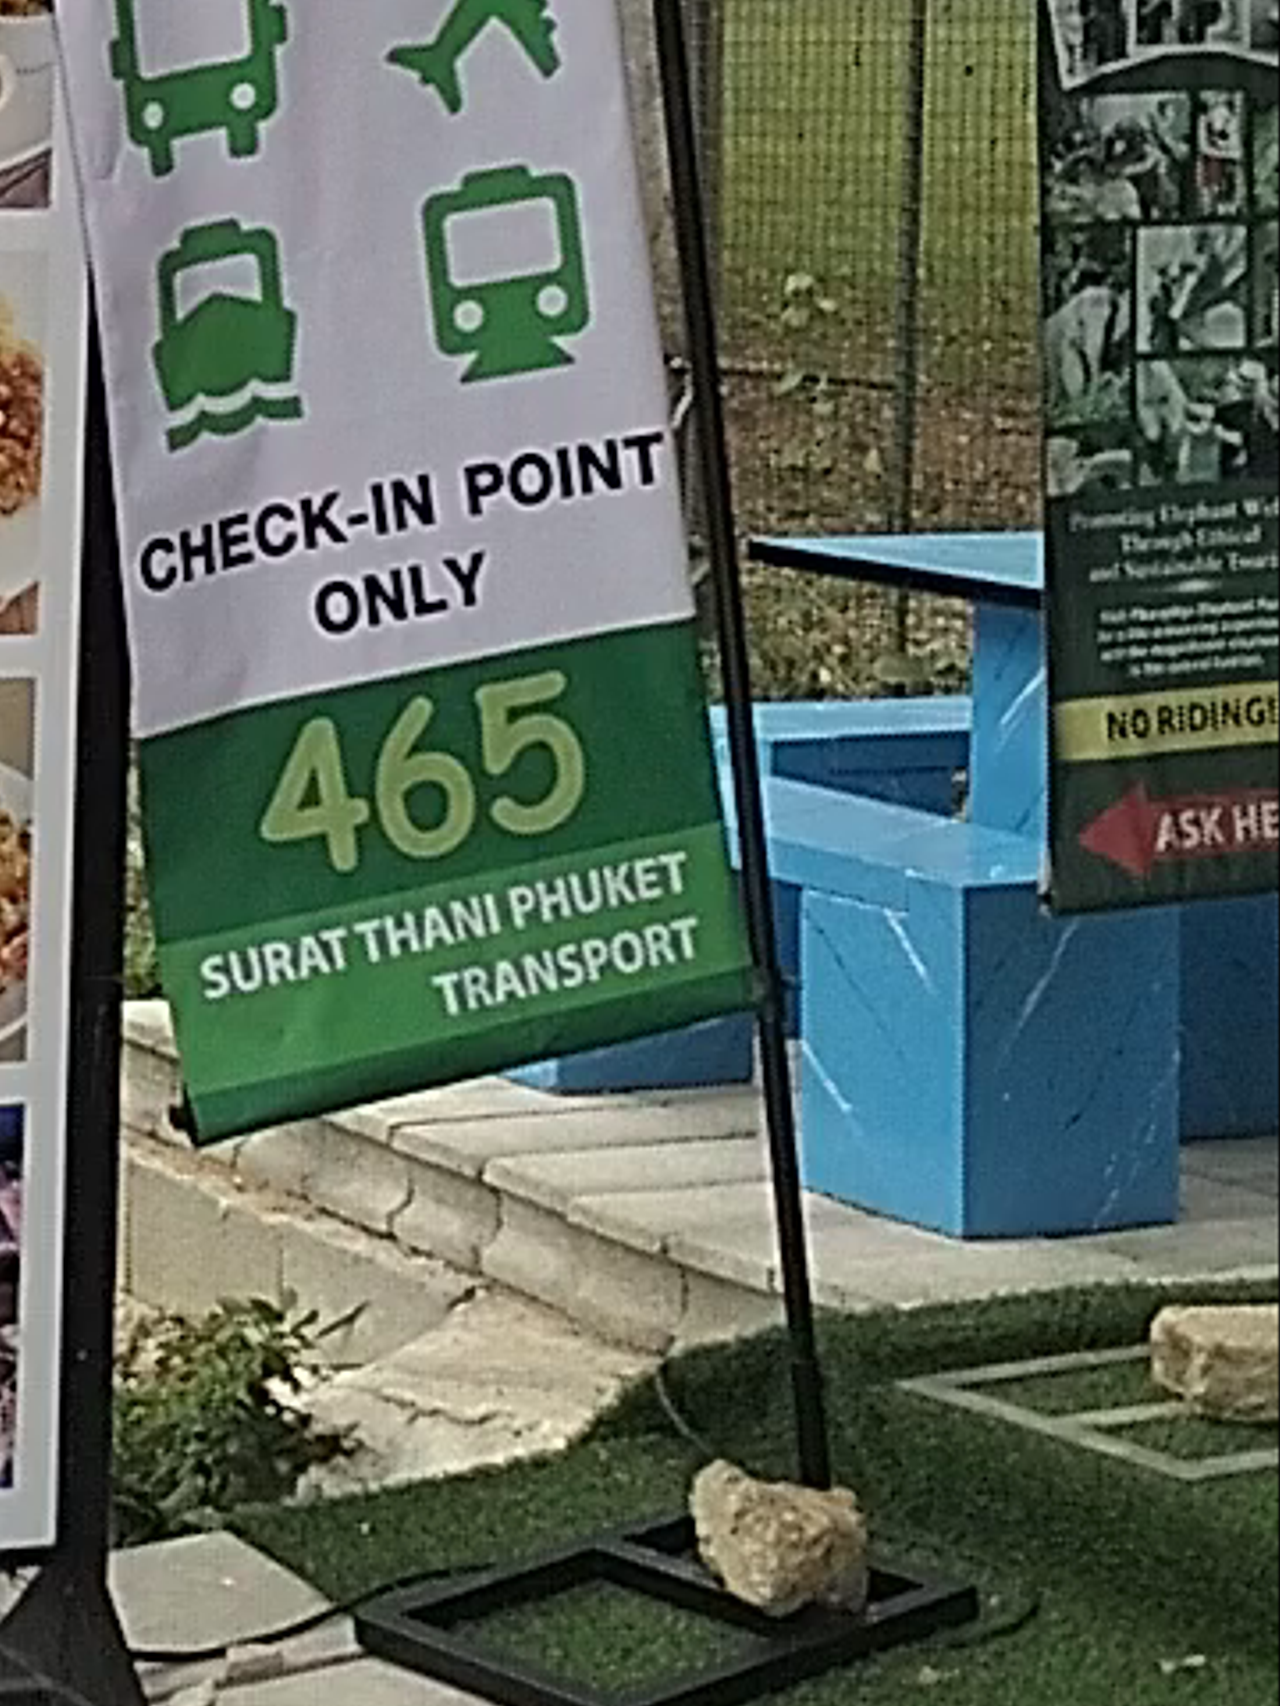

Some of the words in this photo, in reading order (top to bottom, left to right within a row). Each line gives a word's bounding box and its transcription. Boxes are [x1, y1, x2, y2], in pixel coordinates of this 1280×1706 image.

[139, 471, 437, 593] CHECK-IN
[464, 431, 665, 517] POINT
[315, 550, 487, 635] ONLY
[259, 669, 585, 873] 465
[1106, 709, 1152, 742] NO
[1155, 807, 1225, 853] ASK
[199, 925, 350, 1000] SURAT
[352, 892, 500, 967] THANI
[512, 851, 689, 930] PHUKET
[430, 915, 700, 1018] TRANSPORT
